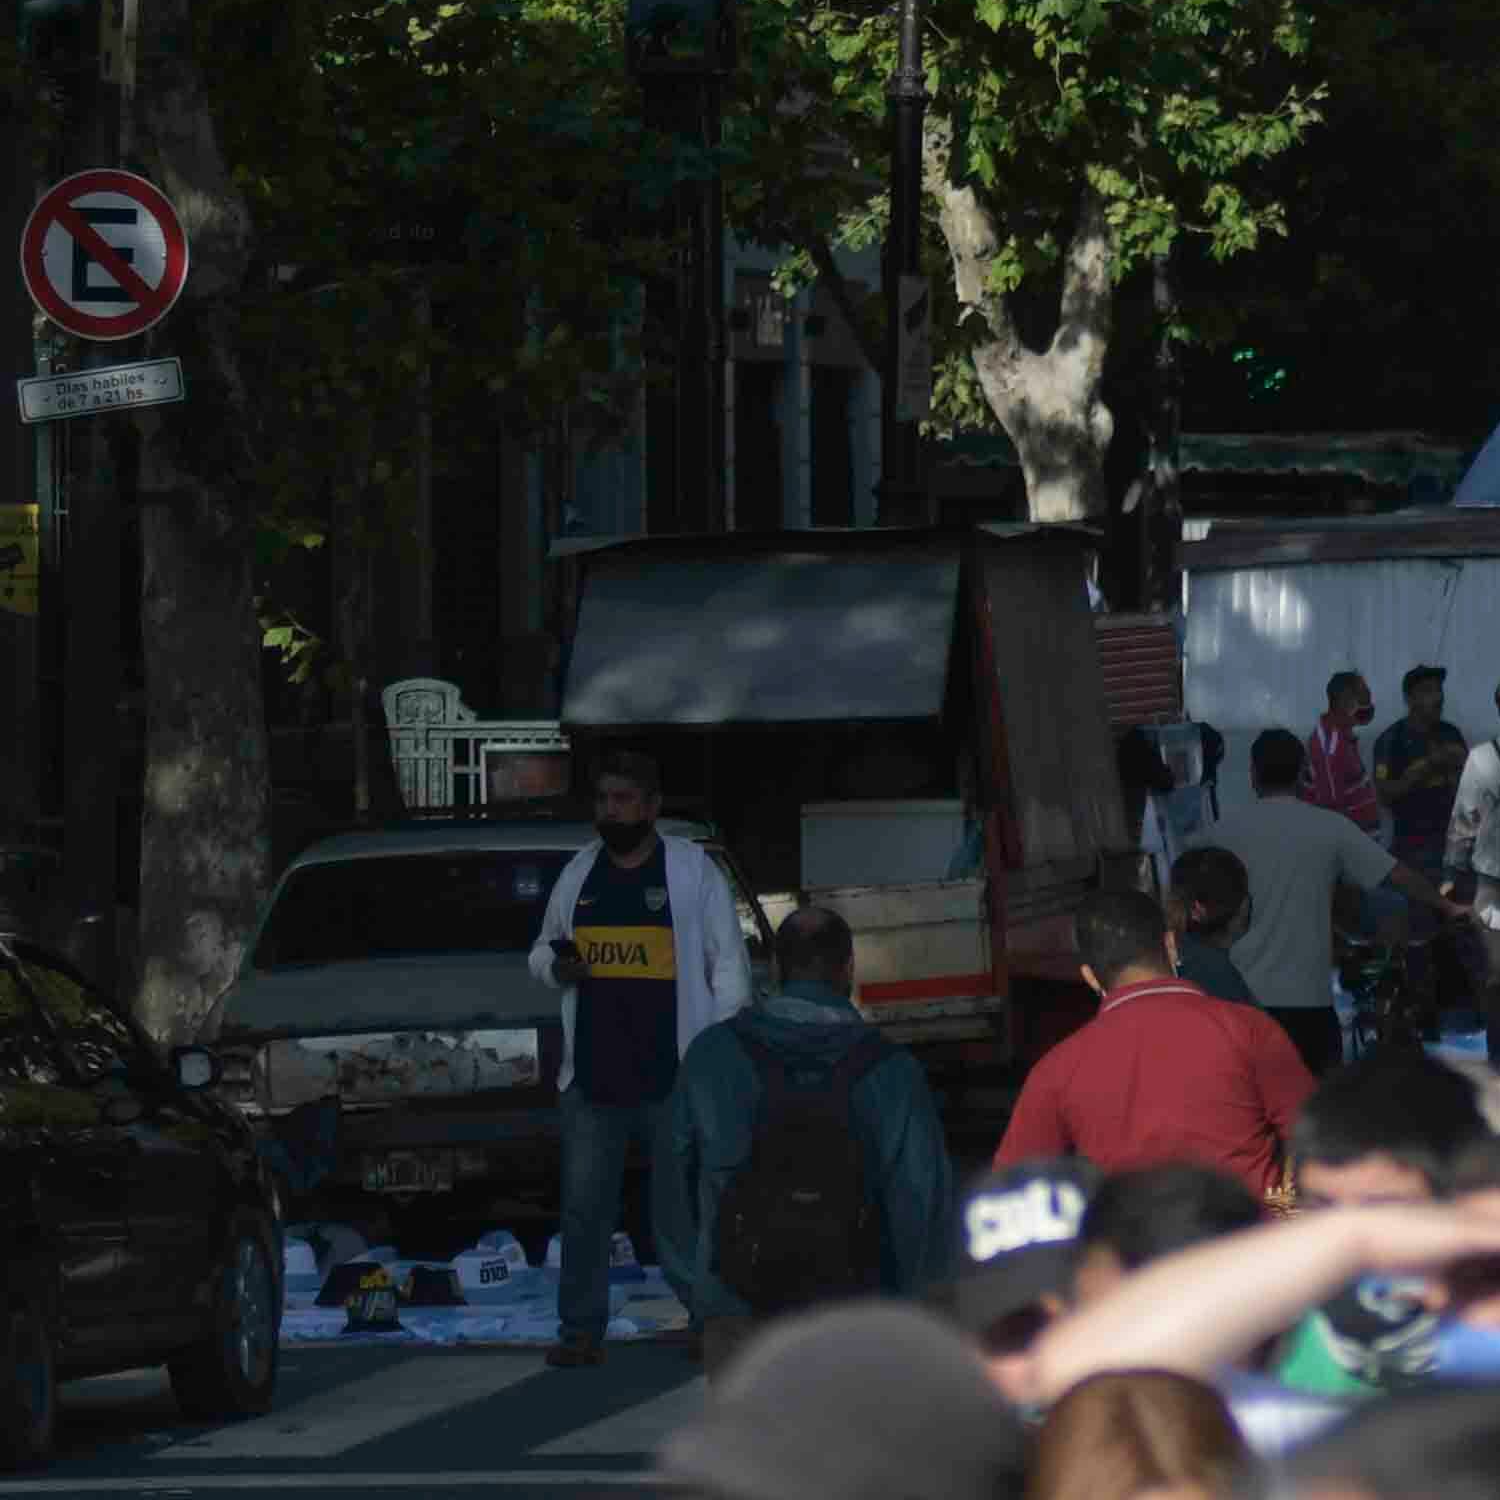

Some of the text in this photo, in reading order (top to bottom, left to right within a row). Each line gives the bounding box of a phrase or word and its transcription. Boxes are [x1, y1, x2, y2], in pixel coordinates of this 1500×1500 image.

[57, 396, 77, 411] de
[80, 394, 88, 406] 7
[93, 395, 101, 405] a
[104, 390, 120, 404] 21
